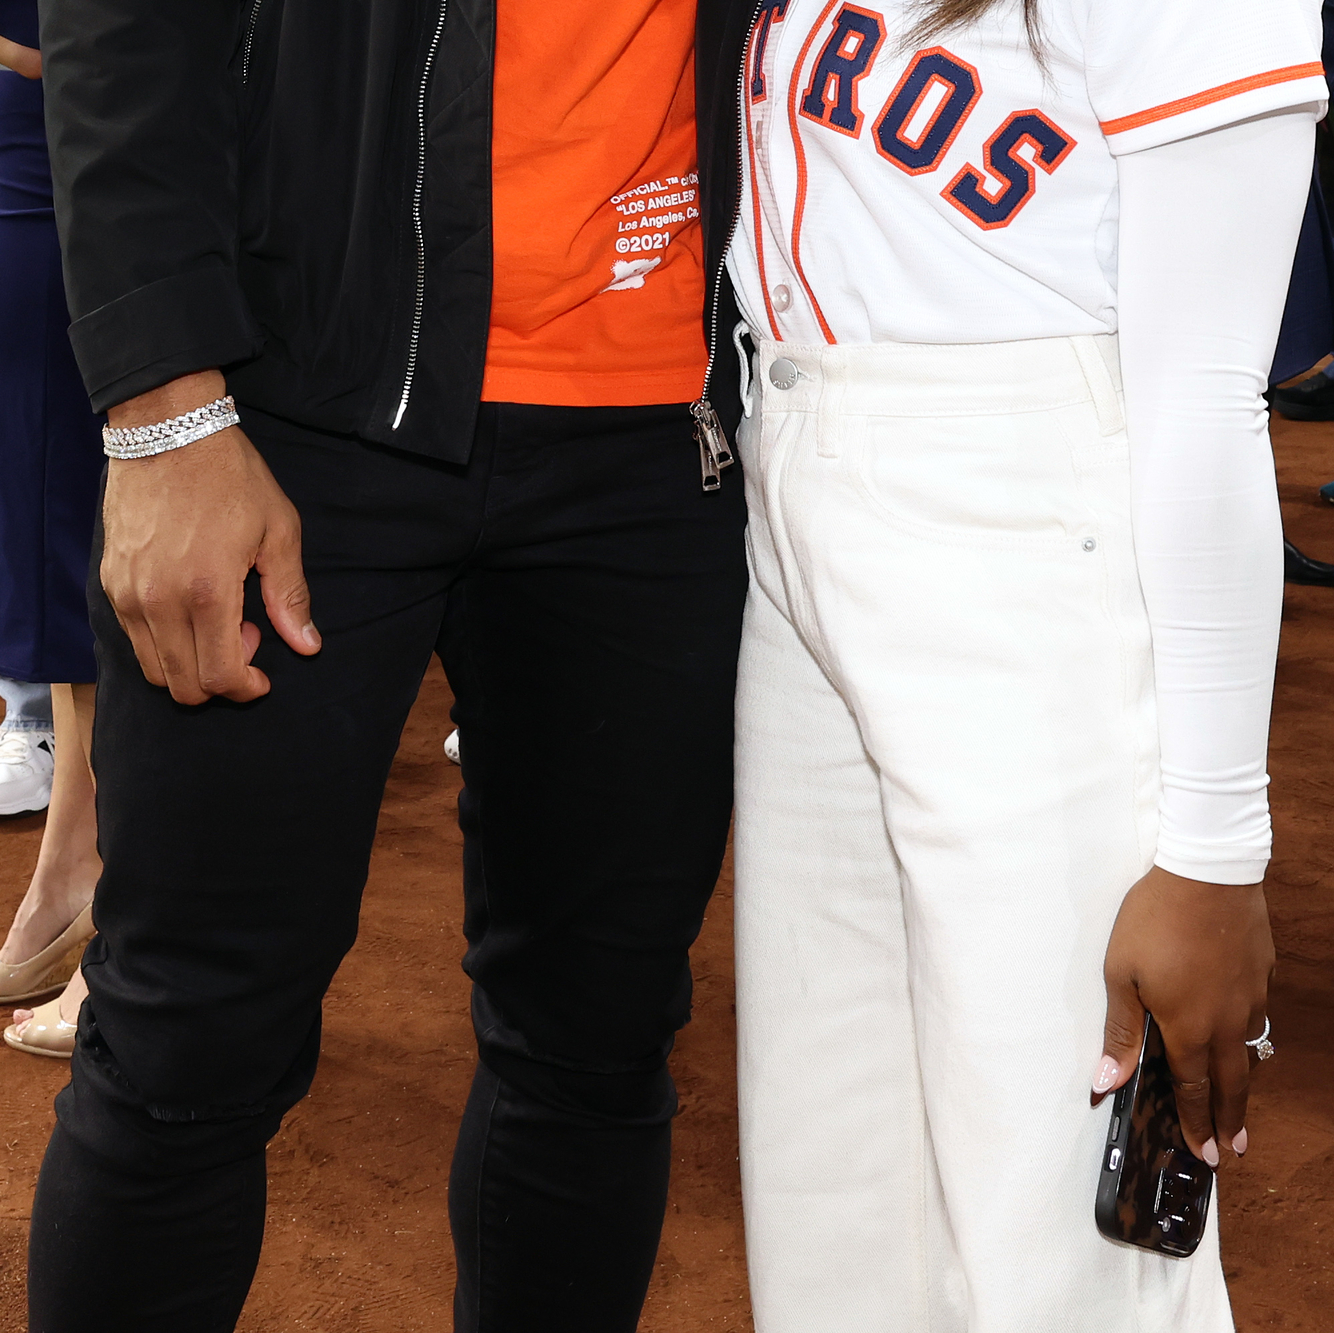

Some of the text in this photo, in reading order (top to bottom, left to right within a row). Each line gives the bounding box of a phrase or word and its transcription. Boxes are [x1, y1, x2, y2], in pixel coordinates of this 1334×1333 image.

[617, 221, 638, 232] Los
[639, 212, 685, 228] Angeles,
[615, 231, 671, 253] ©2021
